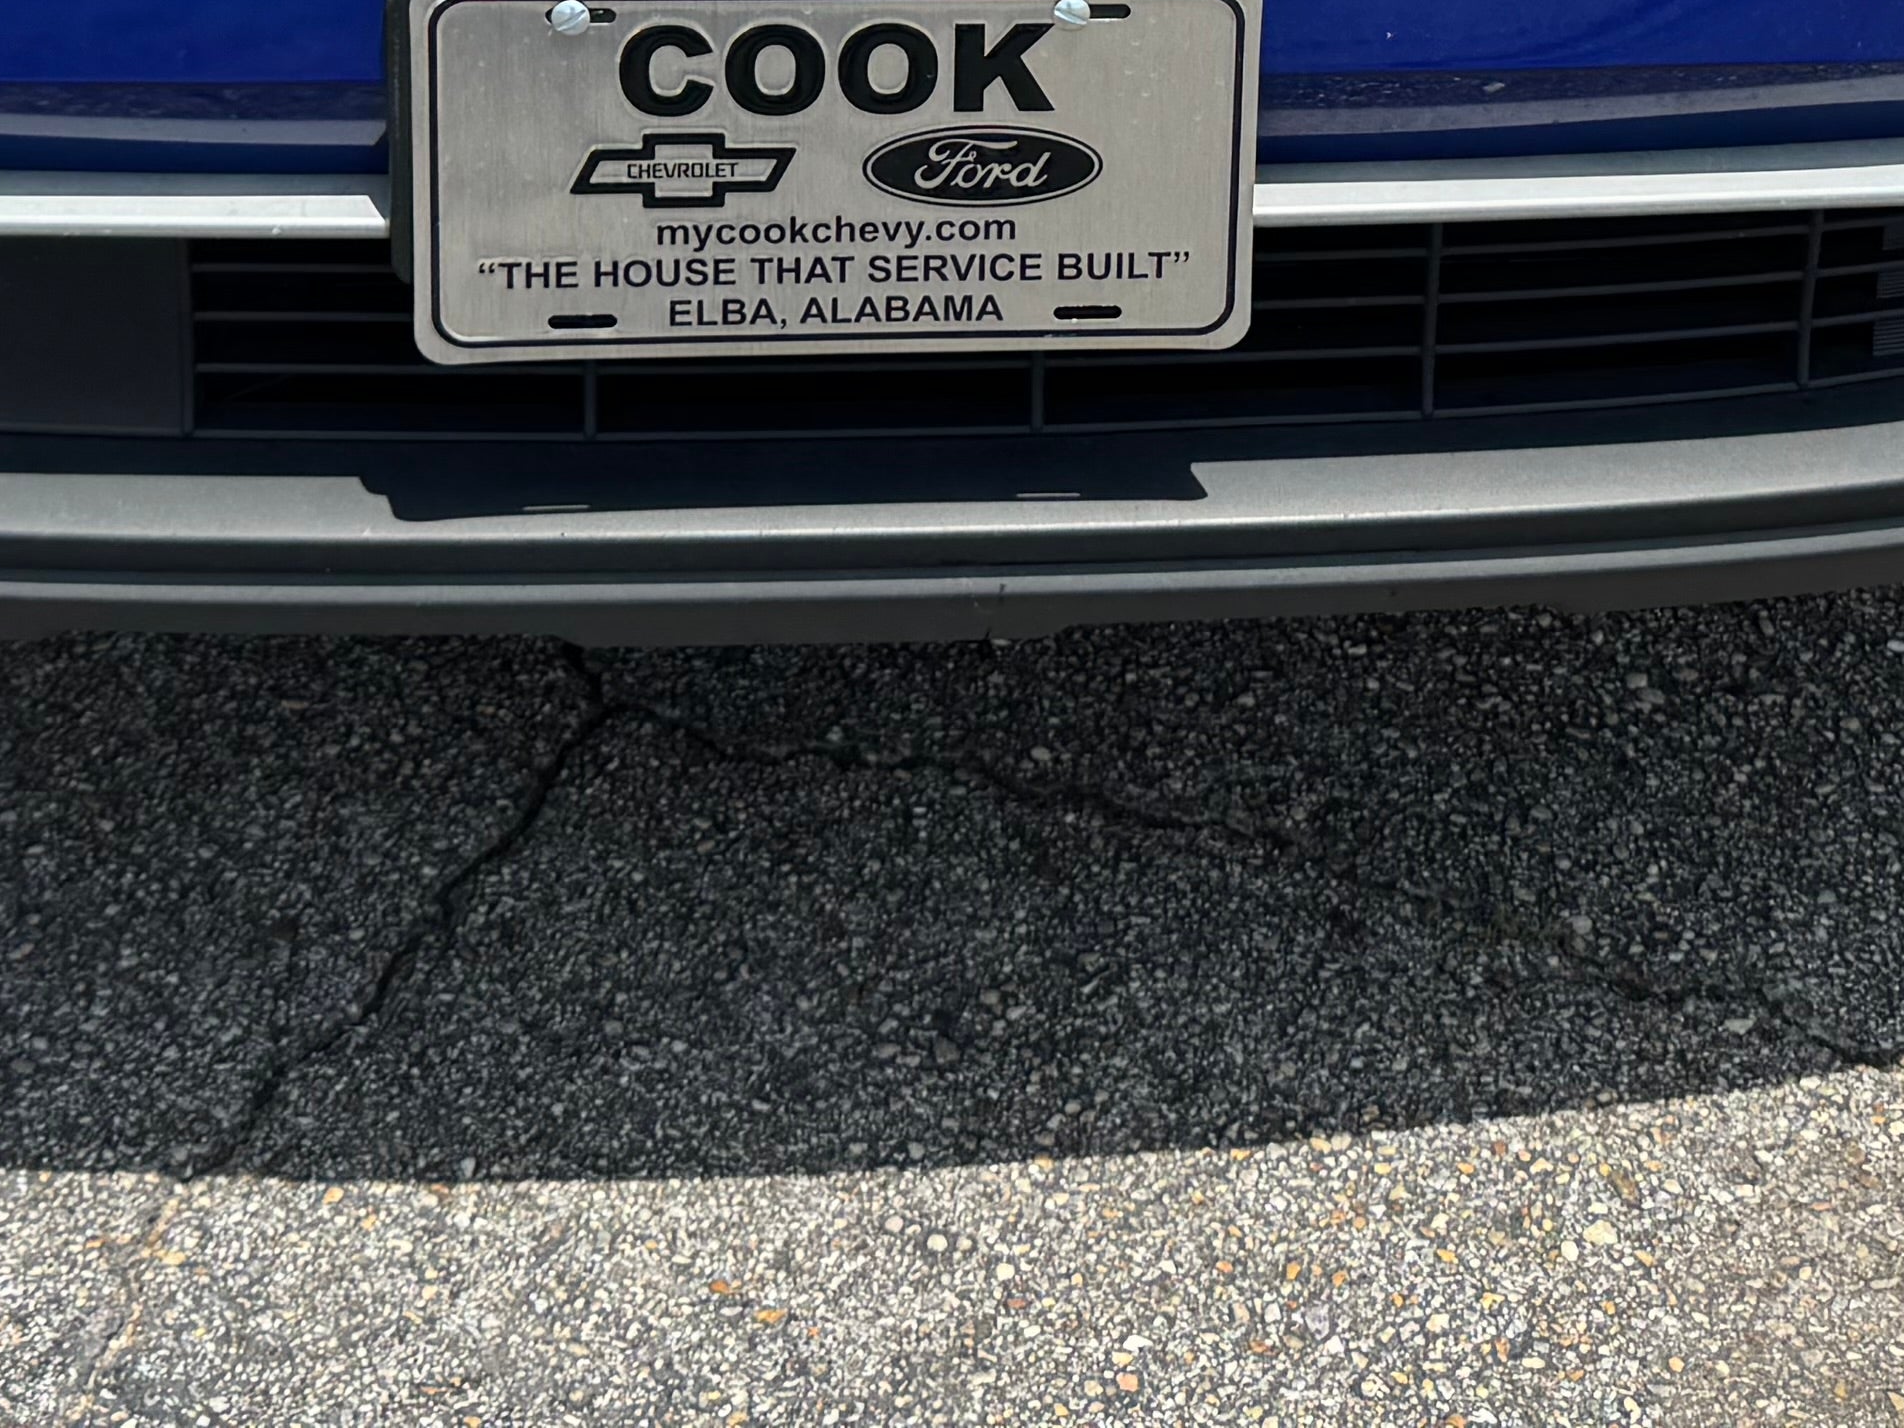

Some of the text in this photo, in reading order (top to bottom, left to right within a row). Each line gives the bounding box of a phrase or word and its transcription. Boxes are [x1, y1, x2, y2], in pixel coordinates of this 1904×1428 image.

[618, 22, 1056, 118] COOK
[626, 161, 740, 180] CHEVROLET
[913, 137, 1052, 190] Ford
[656, 214, 1016, 253] mycookchevy.com
[478, 250, 1190, 291] “THE HOUSE THAT SERVICE BUILT”
[669, 294, 1004, 330] ELBA, ALABAMA
